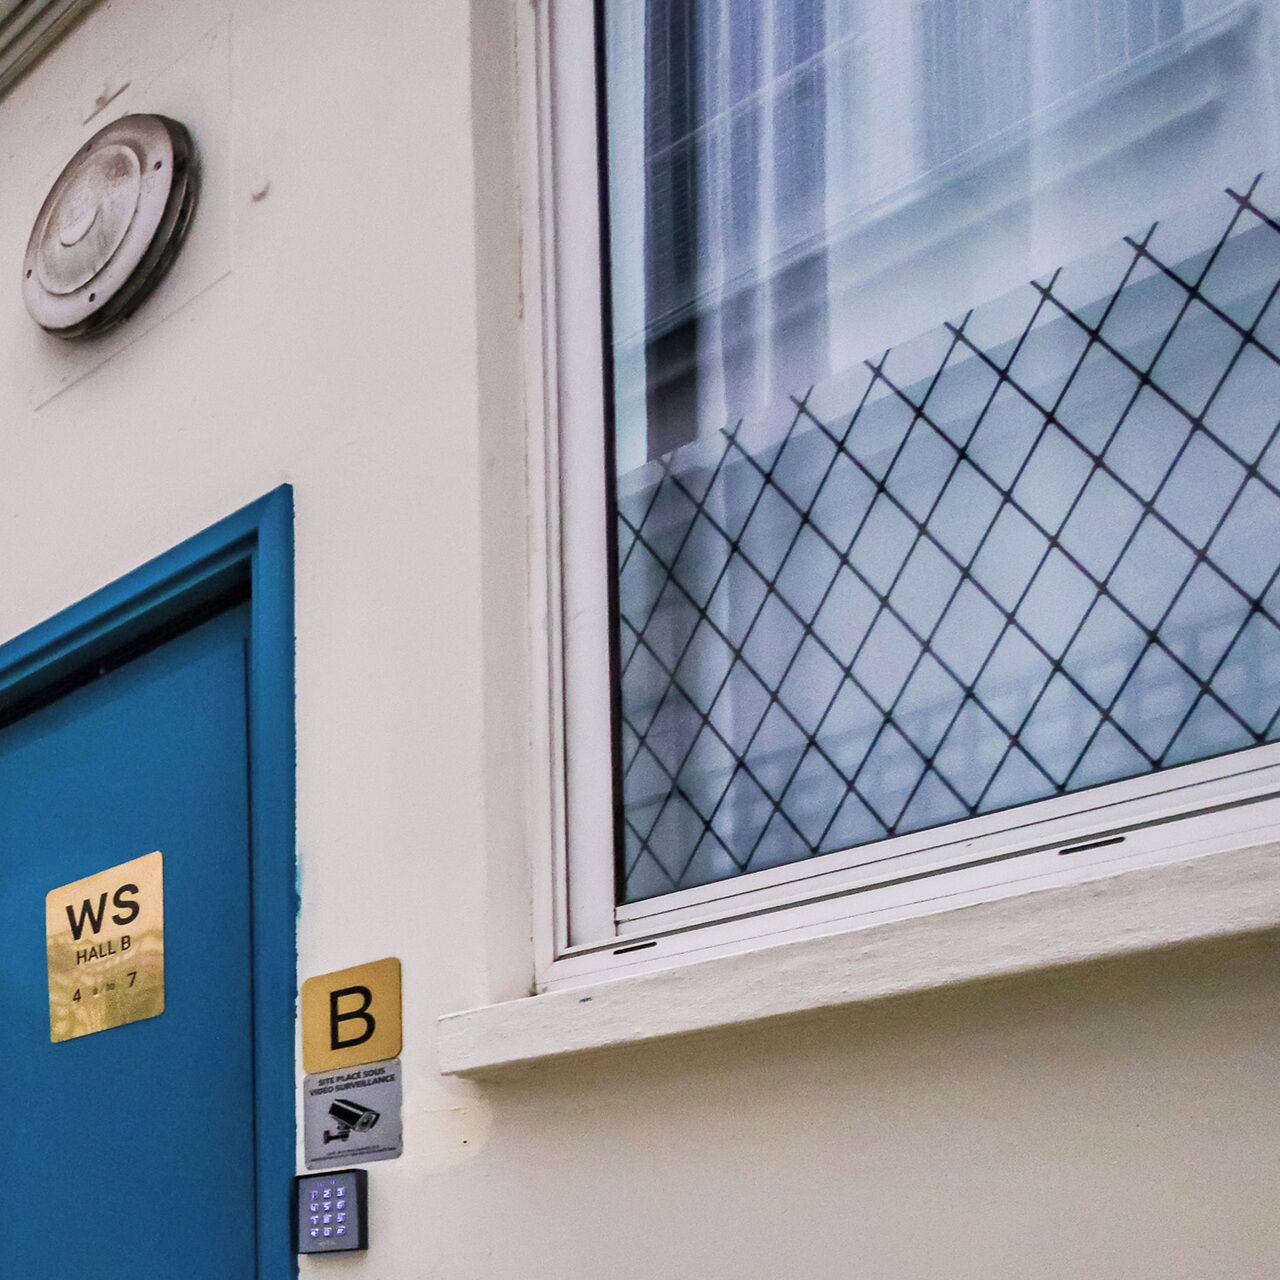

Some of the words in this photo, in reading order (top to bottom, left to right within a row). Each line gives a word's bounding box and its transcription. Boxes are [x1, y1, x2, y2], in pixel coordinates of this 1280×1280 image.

[65, 883, 140, 941] WS
[76, 941, 116, 965] HALL
[120, 935, 132, 951] B
[72, 988, 82, 1003] 4
[127, 971, 137, 988] 7
[329, 985, 376, 1051] B
[318, 1077, 336, 1087] SITE
[363, 1067, 386, 1078] SOUS
[335, 1074, 396, 1092] SURVEILLANCE
